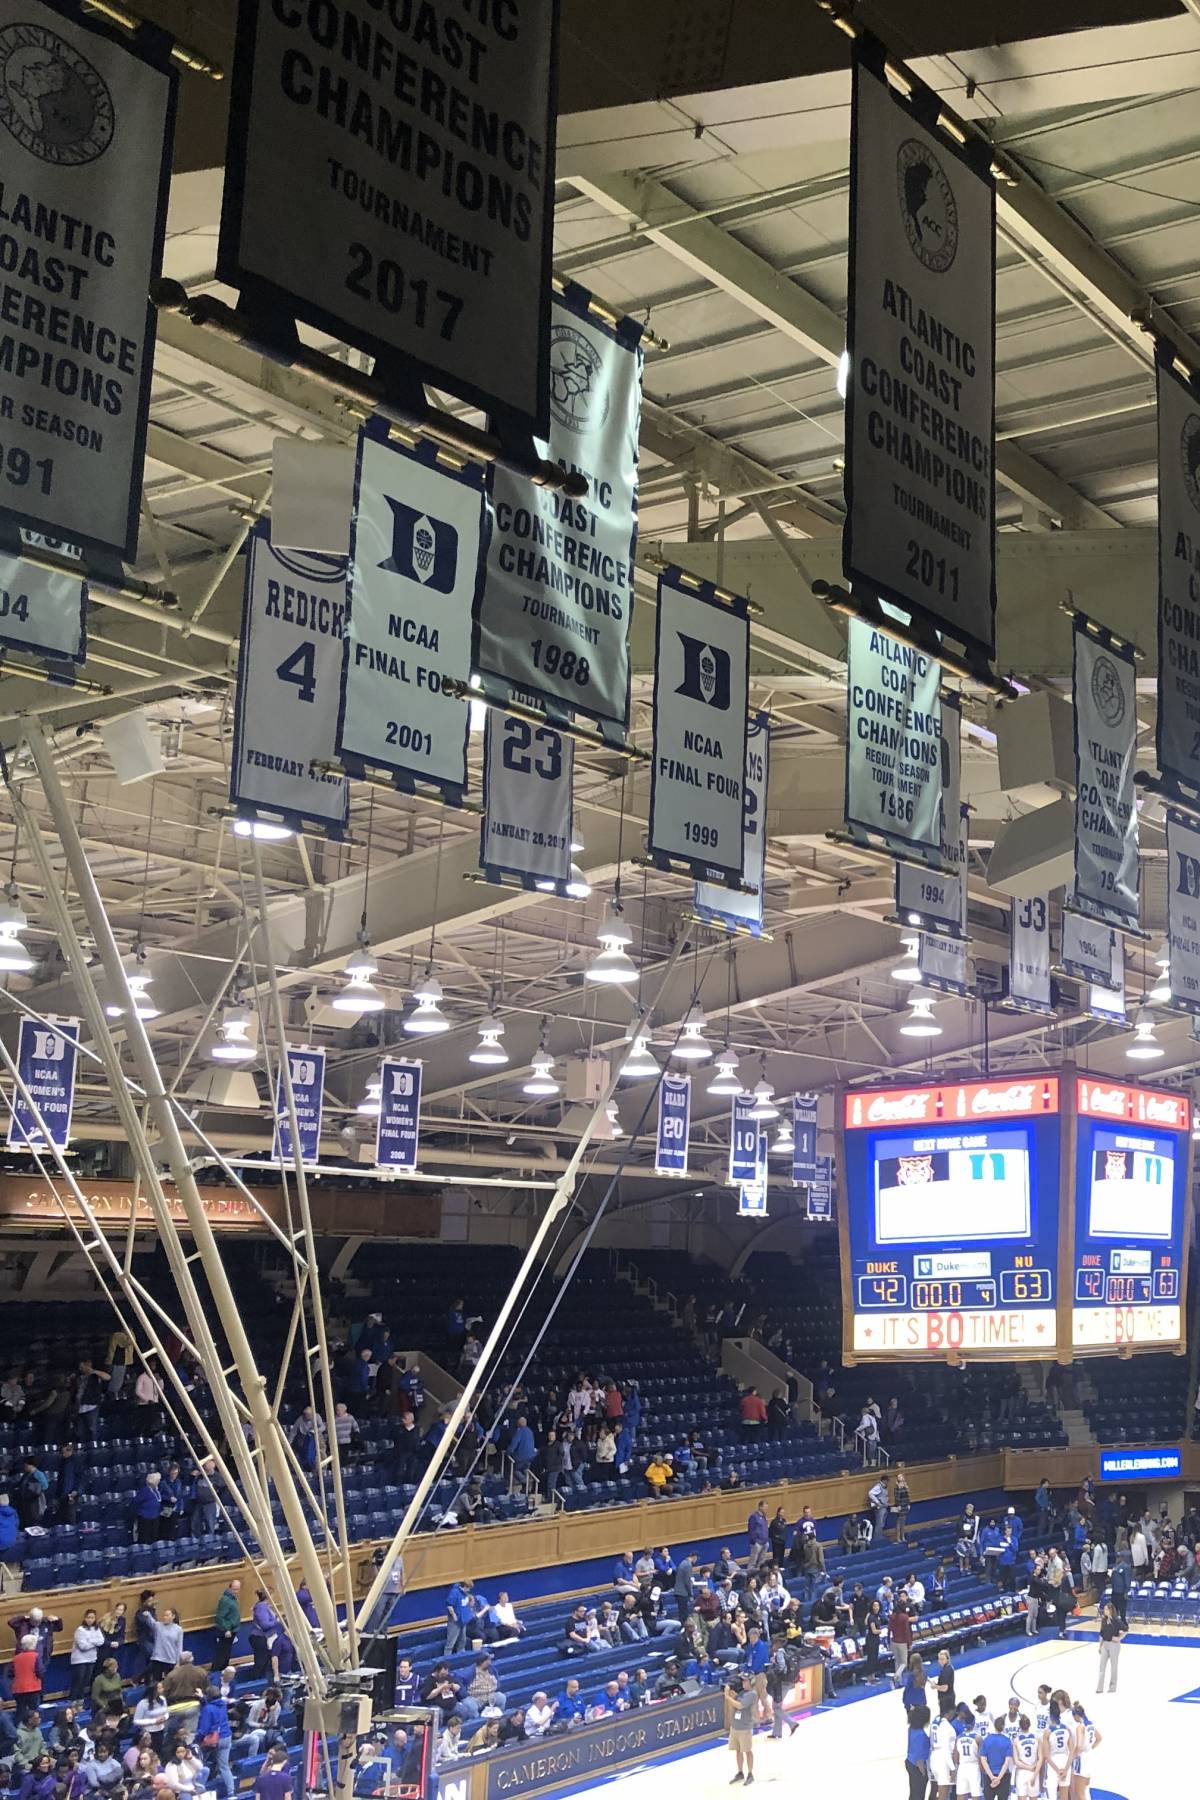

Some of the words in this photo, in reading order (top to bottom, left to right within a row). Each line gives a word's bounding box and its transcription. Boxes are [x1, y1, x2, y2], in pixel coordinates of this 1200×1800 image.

[366, 0, 488, 84] OAST
[280, 48, 532, 242] CHAMPIONS
[328, 156, 494, 276] TOURNAMENT
[345, 241, 464, 341] 2017
[882, 278, 976, 378] ATLANTIC
[900, 336, 963, 413] COAST
[21, 404, 103, 453] SEASON
[860, 356, 990, 480] CONFERENCE
[0, 444, 54, 495] 91
[867, 409, 988, 523] CHAMPIONS
[893, 483, 971, 552] TOURNAMENT
[496, 503, 627, 588] CONFERENCE
[499, 544, 623, 620] CHAMPIONS
[906, 540, 959, 602] 2011
[265, 579, 345, 640] REDICK
[522, 595, 600, 646] TOURNAMENT
[388, 614, 439, 652] NCAA
[276, 641, 317, 703] 4
[355, 643, 411, 684] FINAL
[530, 638, 590, 687] 1988
[881, 665, 917, 702] COAT
[853, 685, 942, 739] CONFEENCE
[385, 721, 432, 756] 2001
[503, 717, 562, 781] 23
[684, 730, 723, 760] NCAA
[246, 749, 304, 775] FEBRUARY
[899, 761, 930, 783] SEASON
[660, 757, 702, 788] FINAL
[707, 772, 739, 801] FOUR
[872, 767, 922, 798] TOURMENT
[492, 822, 529, 843] JANUARY
[684, 821, 719, 849] 1999
[920, 882, 945, 905] 1994
[1101, 869, 1124, 895] 19
[35, 1069, 58, 1080] NCAA
[44, 1102, 68, 1113] FOUR
[386, 1116, 413, 1126] WOMEN'S
[392, 1103, 409, 1113] NCAA
[299, 1122, 317, 1132] FOUR
[381, 1128, 399, 1138] FINAL
[400, 1130, 416, 1140] FOUR
[664, 1116, 684, 1139] 20
[737, 1131, 754, 1151] 10
[802, 1133, 808, 1153] 1
[200, 1198, 257, 1215] TADIUM
[866, 1261, 898, 1274] DUKE
[1014, 1256, 1033, 1268] NU
[873, 1278, 898, 1302] 42
[917, 1282, 961, 1307] 00.0
[981, 1291, 990, 1302] 4
[1014, 1273, 1042, 1298] 63
[1160, 1272, 1174, 1294] 63
[883, 1318, 919, 1345] IT'S
[927, 1311, 964, 1349] BO
[970, 1315, 1025, 1343] TIME!
[497, 1748, 581, 1790] CAMERON
[588, 1728, 648, 1763] INDOOR
[656, 1706, 717, 1740] STADIUM
[1024, 1746, 1032, 1757] 3
[1056, 1737, 1064, 1749] 5
